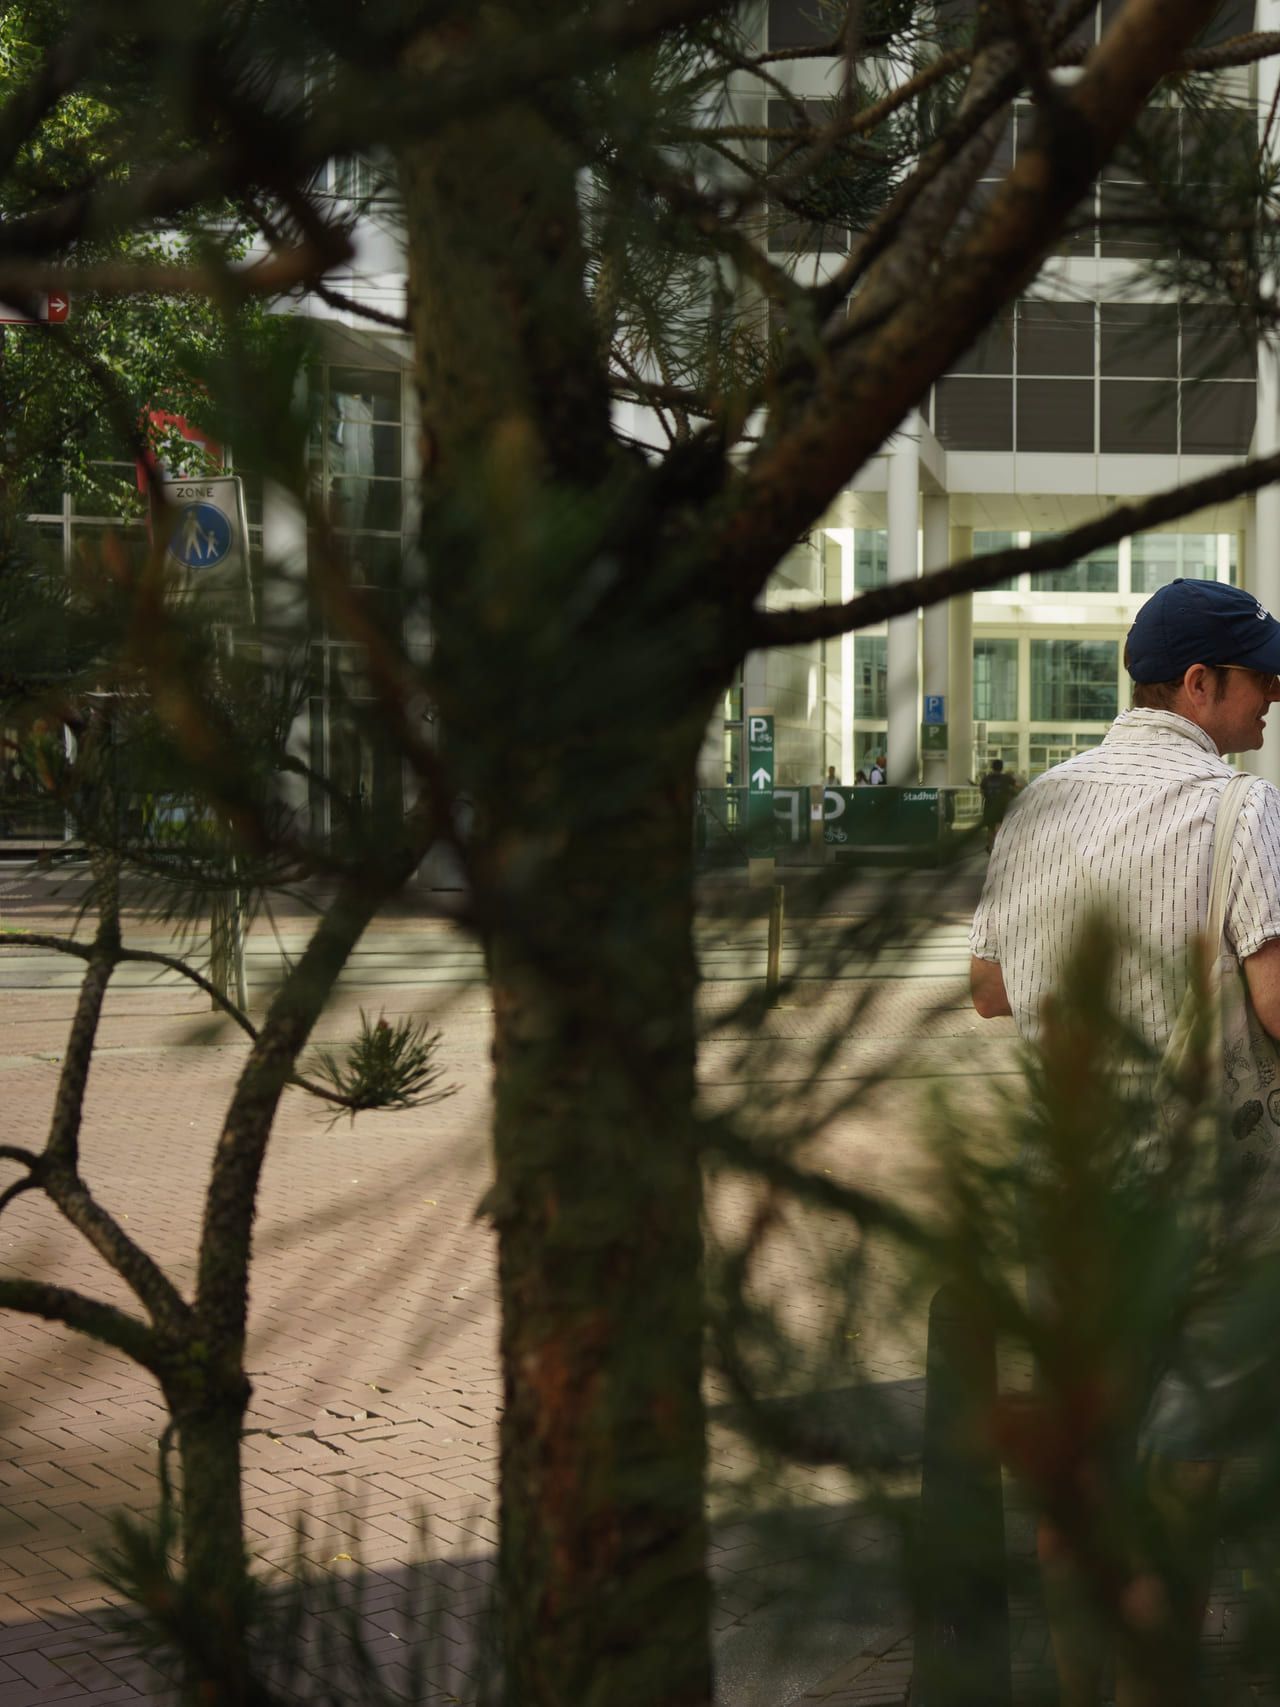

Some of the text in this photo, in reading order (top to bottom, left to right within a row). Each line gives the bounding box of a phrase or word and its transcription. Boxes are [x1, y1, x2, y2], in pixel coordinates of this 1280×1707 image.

[176, 487, 214, 498] ZONE
[929, 698, 939, 711] P
[750, 717, 768, 743] P
[903, 791, 938, 801] Stadhui
